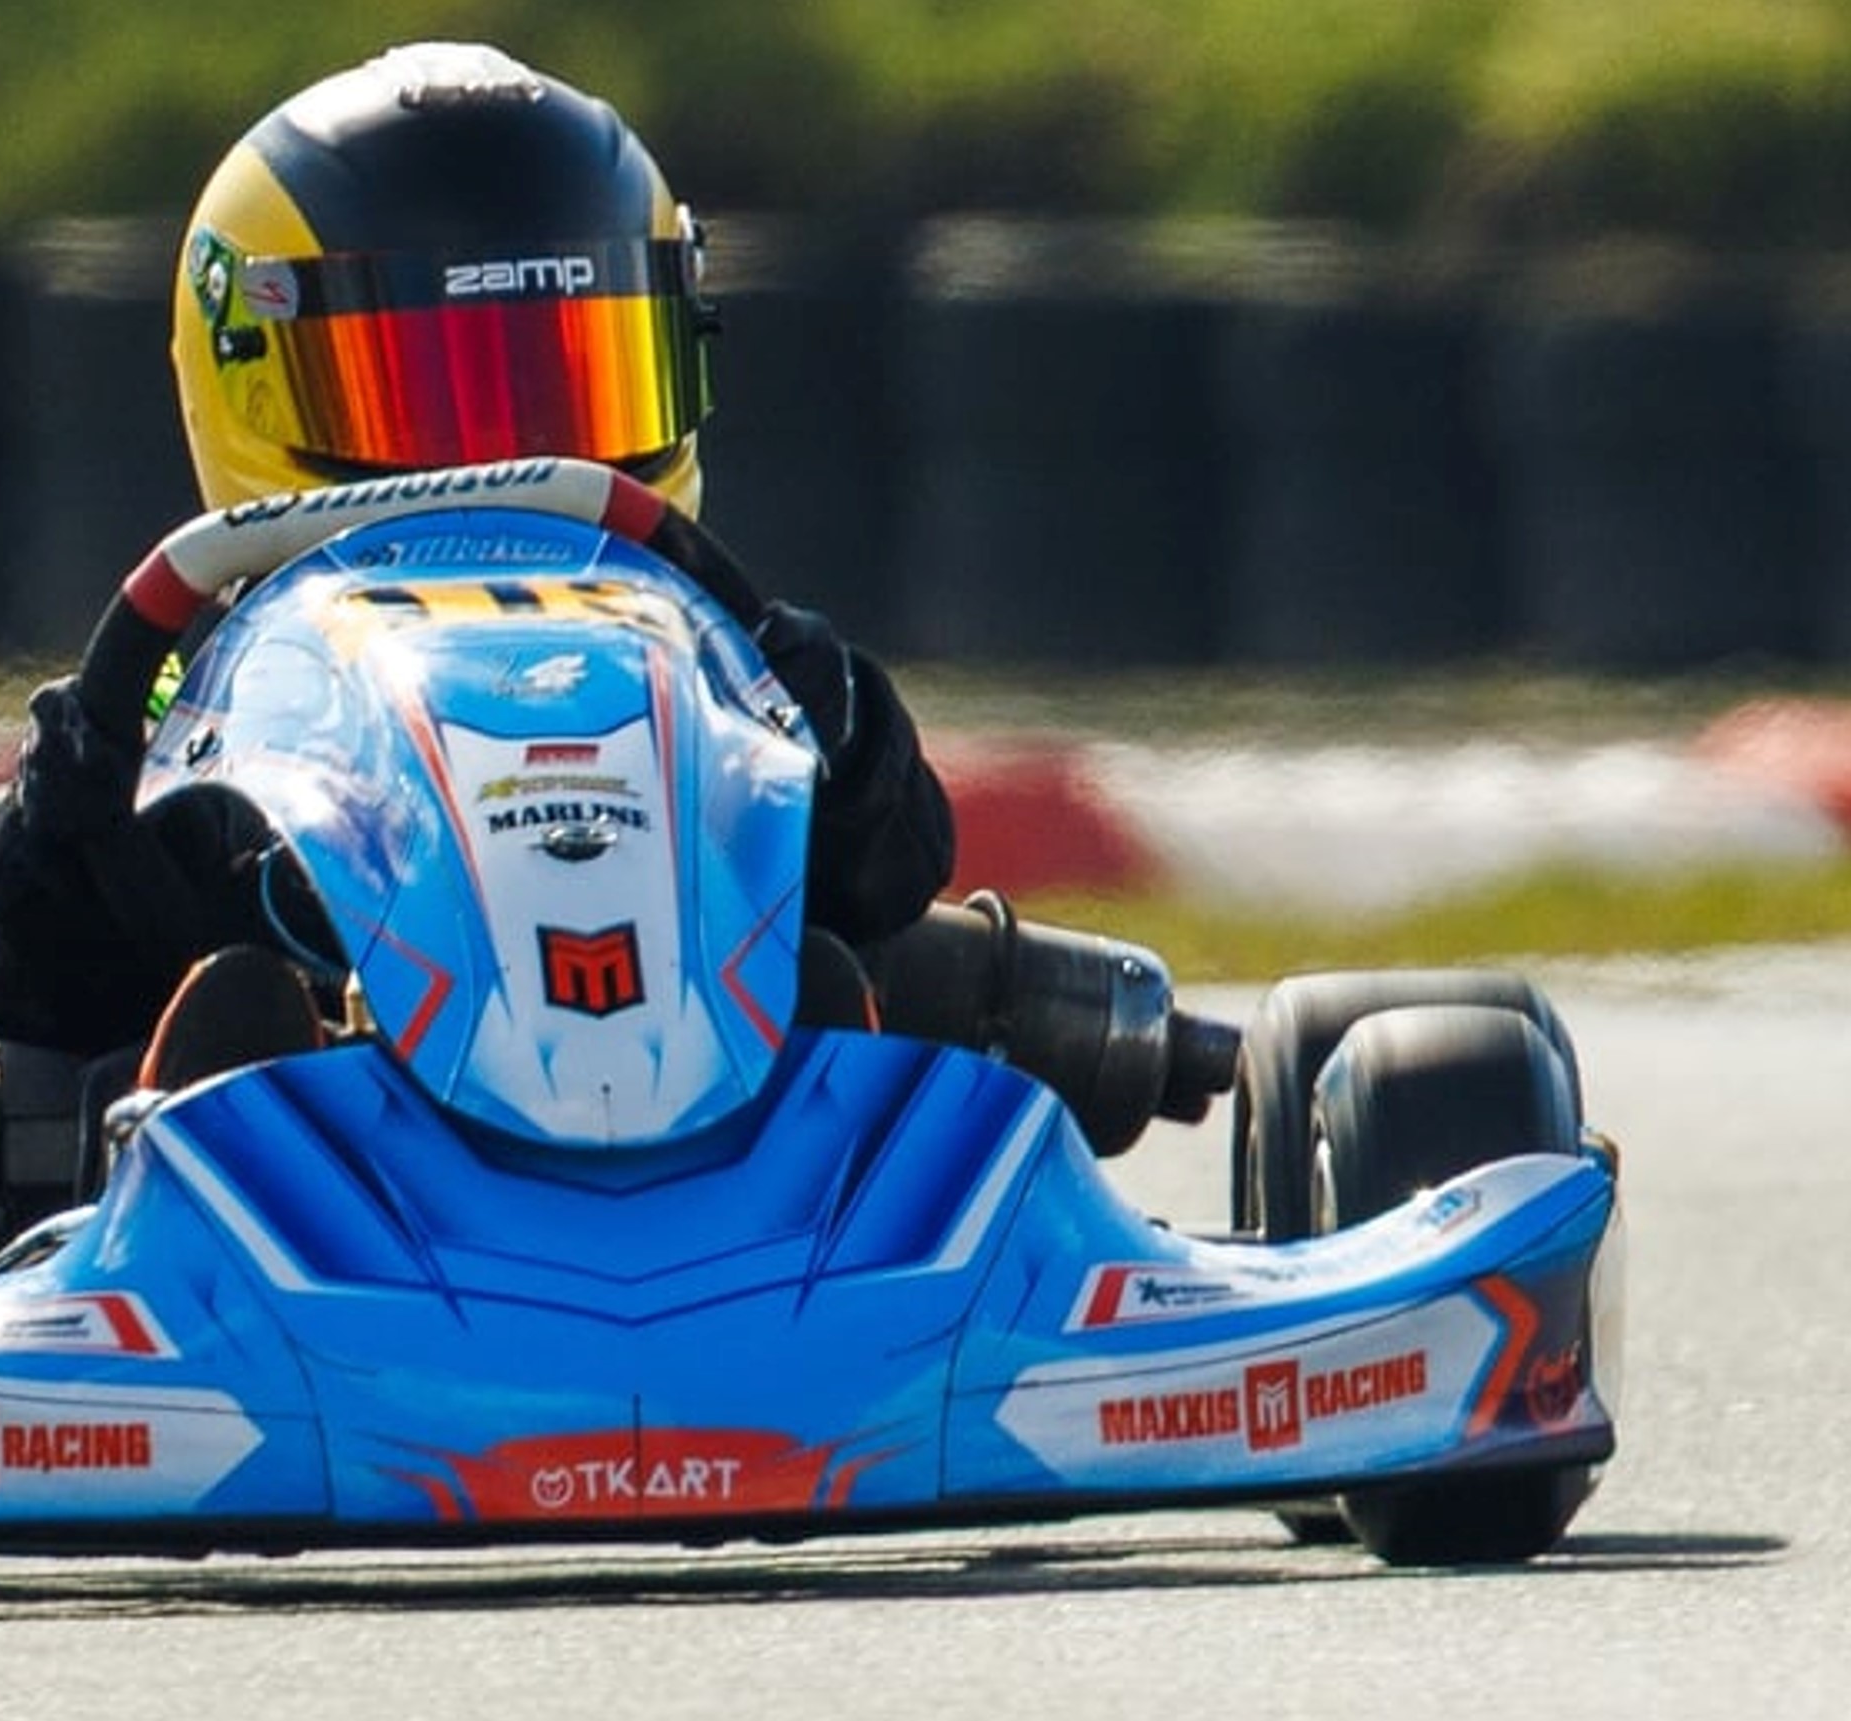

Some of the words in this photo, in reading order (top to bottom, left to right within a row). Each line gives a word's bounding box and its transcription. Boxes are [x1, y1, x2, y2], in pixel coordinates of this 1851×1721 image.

[445, 255, 595, 296] zamp
[1099, 1387, 1240, 1445] MAXXIS
[1307, 1352, 1427, 1418] RACING
[3, 1421, 153, 1474] RACING
